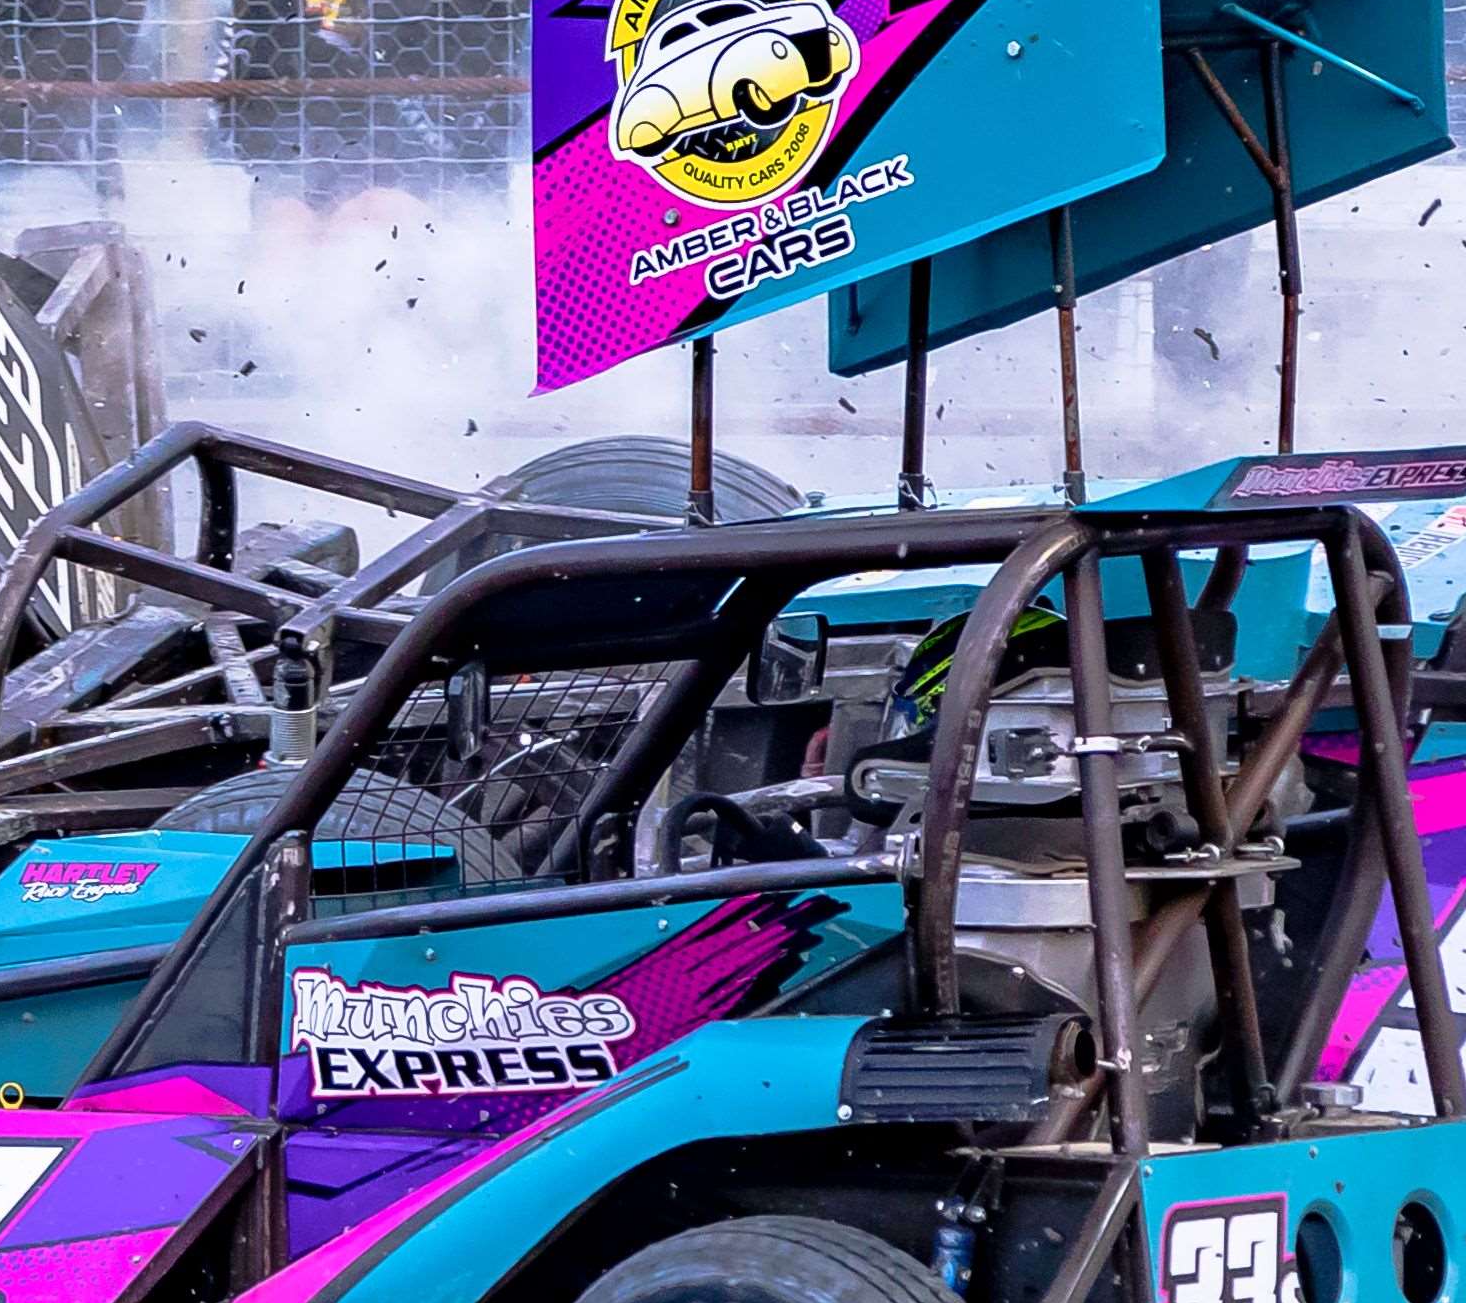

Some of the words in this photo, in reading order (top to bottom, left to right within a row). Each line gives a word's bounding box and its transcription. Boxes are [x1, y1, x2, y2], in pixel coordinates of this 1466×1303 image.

[682, 160, 745, 190] QUALITY
[748, 155, 786, 187] CARS
[782, 122, 811, 159] 2008
[632, 217, 757, 280] AMBER
[763, 208, 783, 230] &
[788, 159, 910, 222] BLACK
[708, 219, 852, 296] CARS
[20, 862, 159, 885] HARTLEY
[72, 878, 140, 902] Engines
[297, 978, 630, 1046] Munchies
[315, 1043, 615, 1090] EXPRESS
